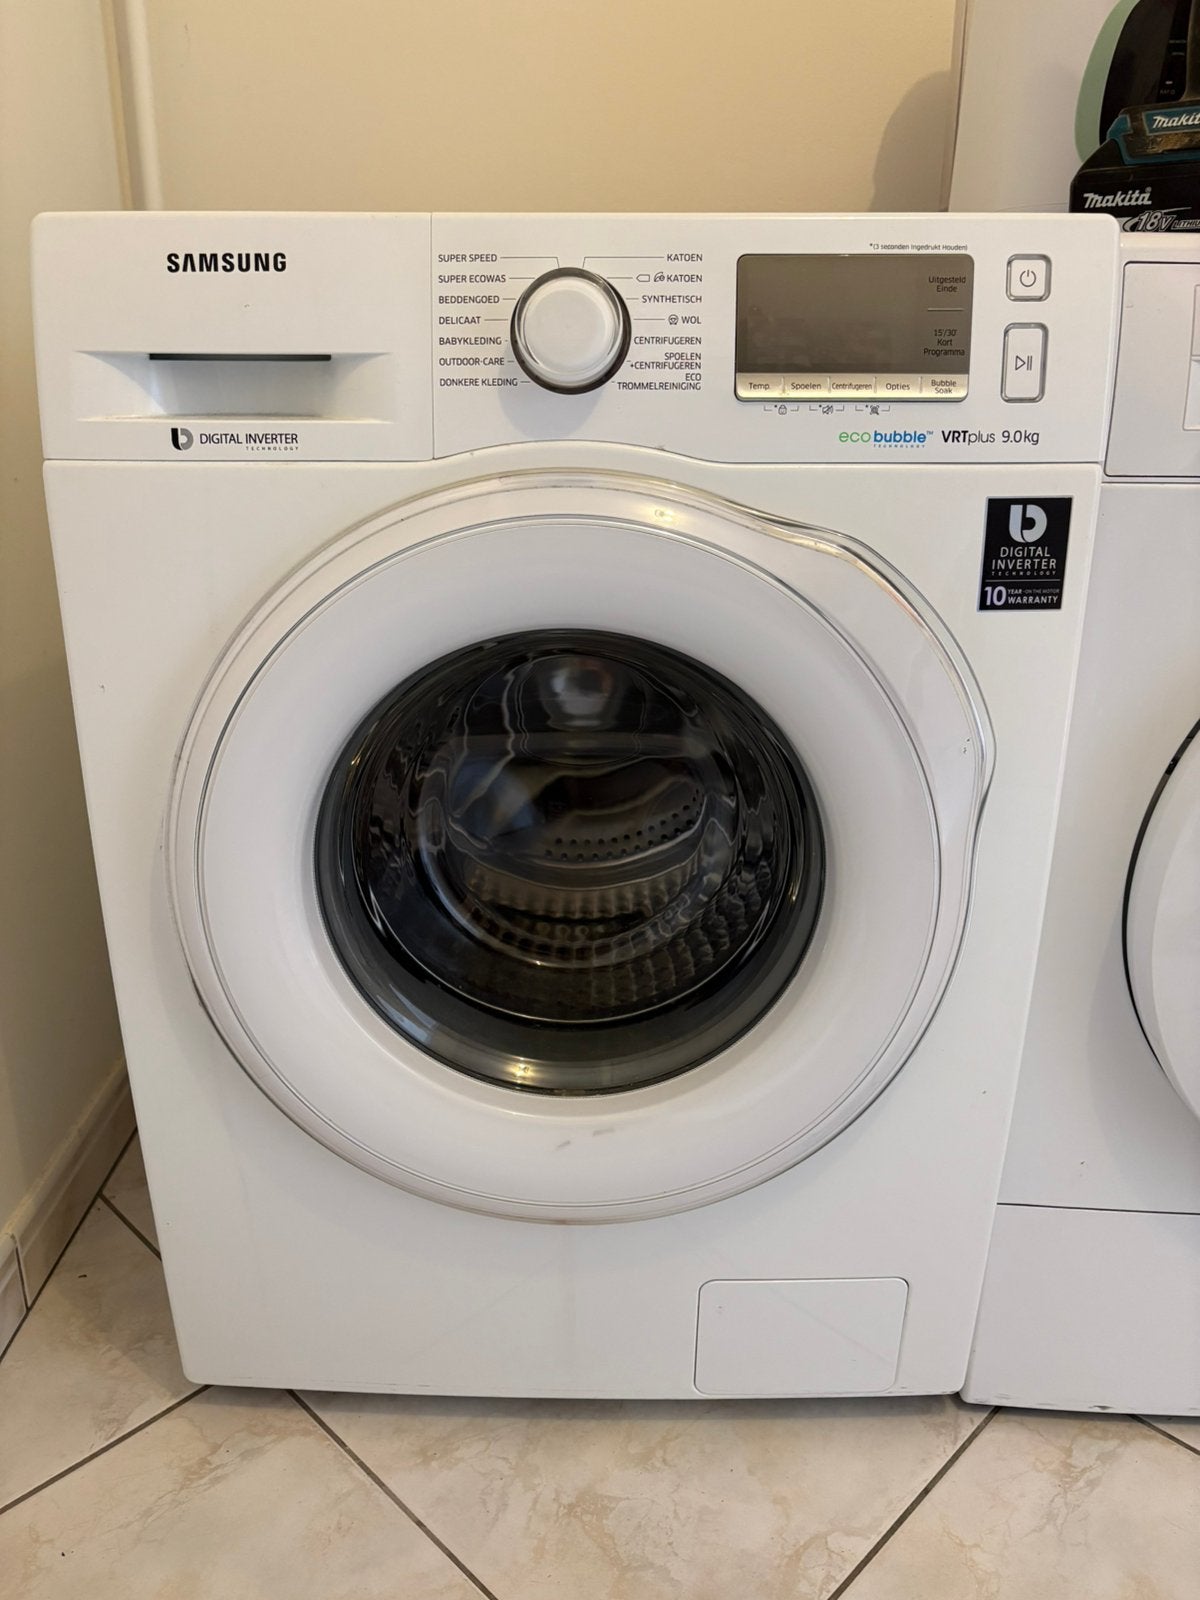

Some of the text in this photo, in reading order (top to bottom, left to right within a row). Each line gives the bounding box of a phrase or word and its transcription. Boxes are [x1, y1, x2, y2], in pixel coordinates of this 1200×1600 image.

[438, 254, 498, 263] SUPER SPEED
[667, 254, 703, 262] KATOEN
[167, 253, 287, 273] SAMSUNG
[438, 274, 506, 283] SUPER ECOWAS
[666, 274, 703, 283] KATOEN
[928, 276, 967, 285] Uitgesteld
[936, 285, 958, 293] Einde
[438, 295, 500, 304] BEDDENGOED
[641, 295, 702, 304] SYNTHETISCH
[438, 316, 481, 325] DELICAAT
[681, 316, 702, 324] WOL
[438, 336, 502, 346] BABYKLEDING
[633, 336, 702, 345] CENTRIFUGEREN
[936, 338, 953, 347] Kort
[664, 352, 702, 361] SPOELEN
[923, 347, 966, 357] Programma
[685, 372, 701, 381] ECO
[439, 378, 518, 387] DONKERE KLEDING
[617, 381, 702, 391] TROMMELREINIGING
[790, 382, 822, 390] Spoelen
[831, 382, 873, 391] Centrifugeren
[885, 382, 911, 391] Opties
[930, 379, 957, 387] Bubble
[199, 433, 299, 444] DIGITAL INVERTER
[941, 430, 996, 445] VRTplus
[1001, 430, 1040, 445] 9.0kg
[1000, 547, 1051, 557] DIGITAL
[991, 559, 1057, 570] INVERTER
[984, 586, 1007, 606] 10
[1007, 595, 1058, 604] WARRANTY
